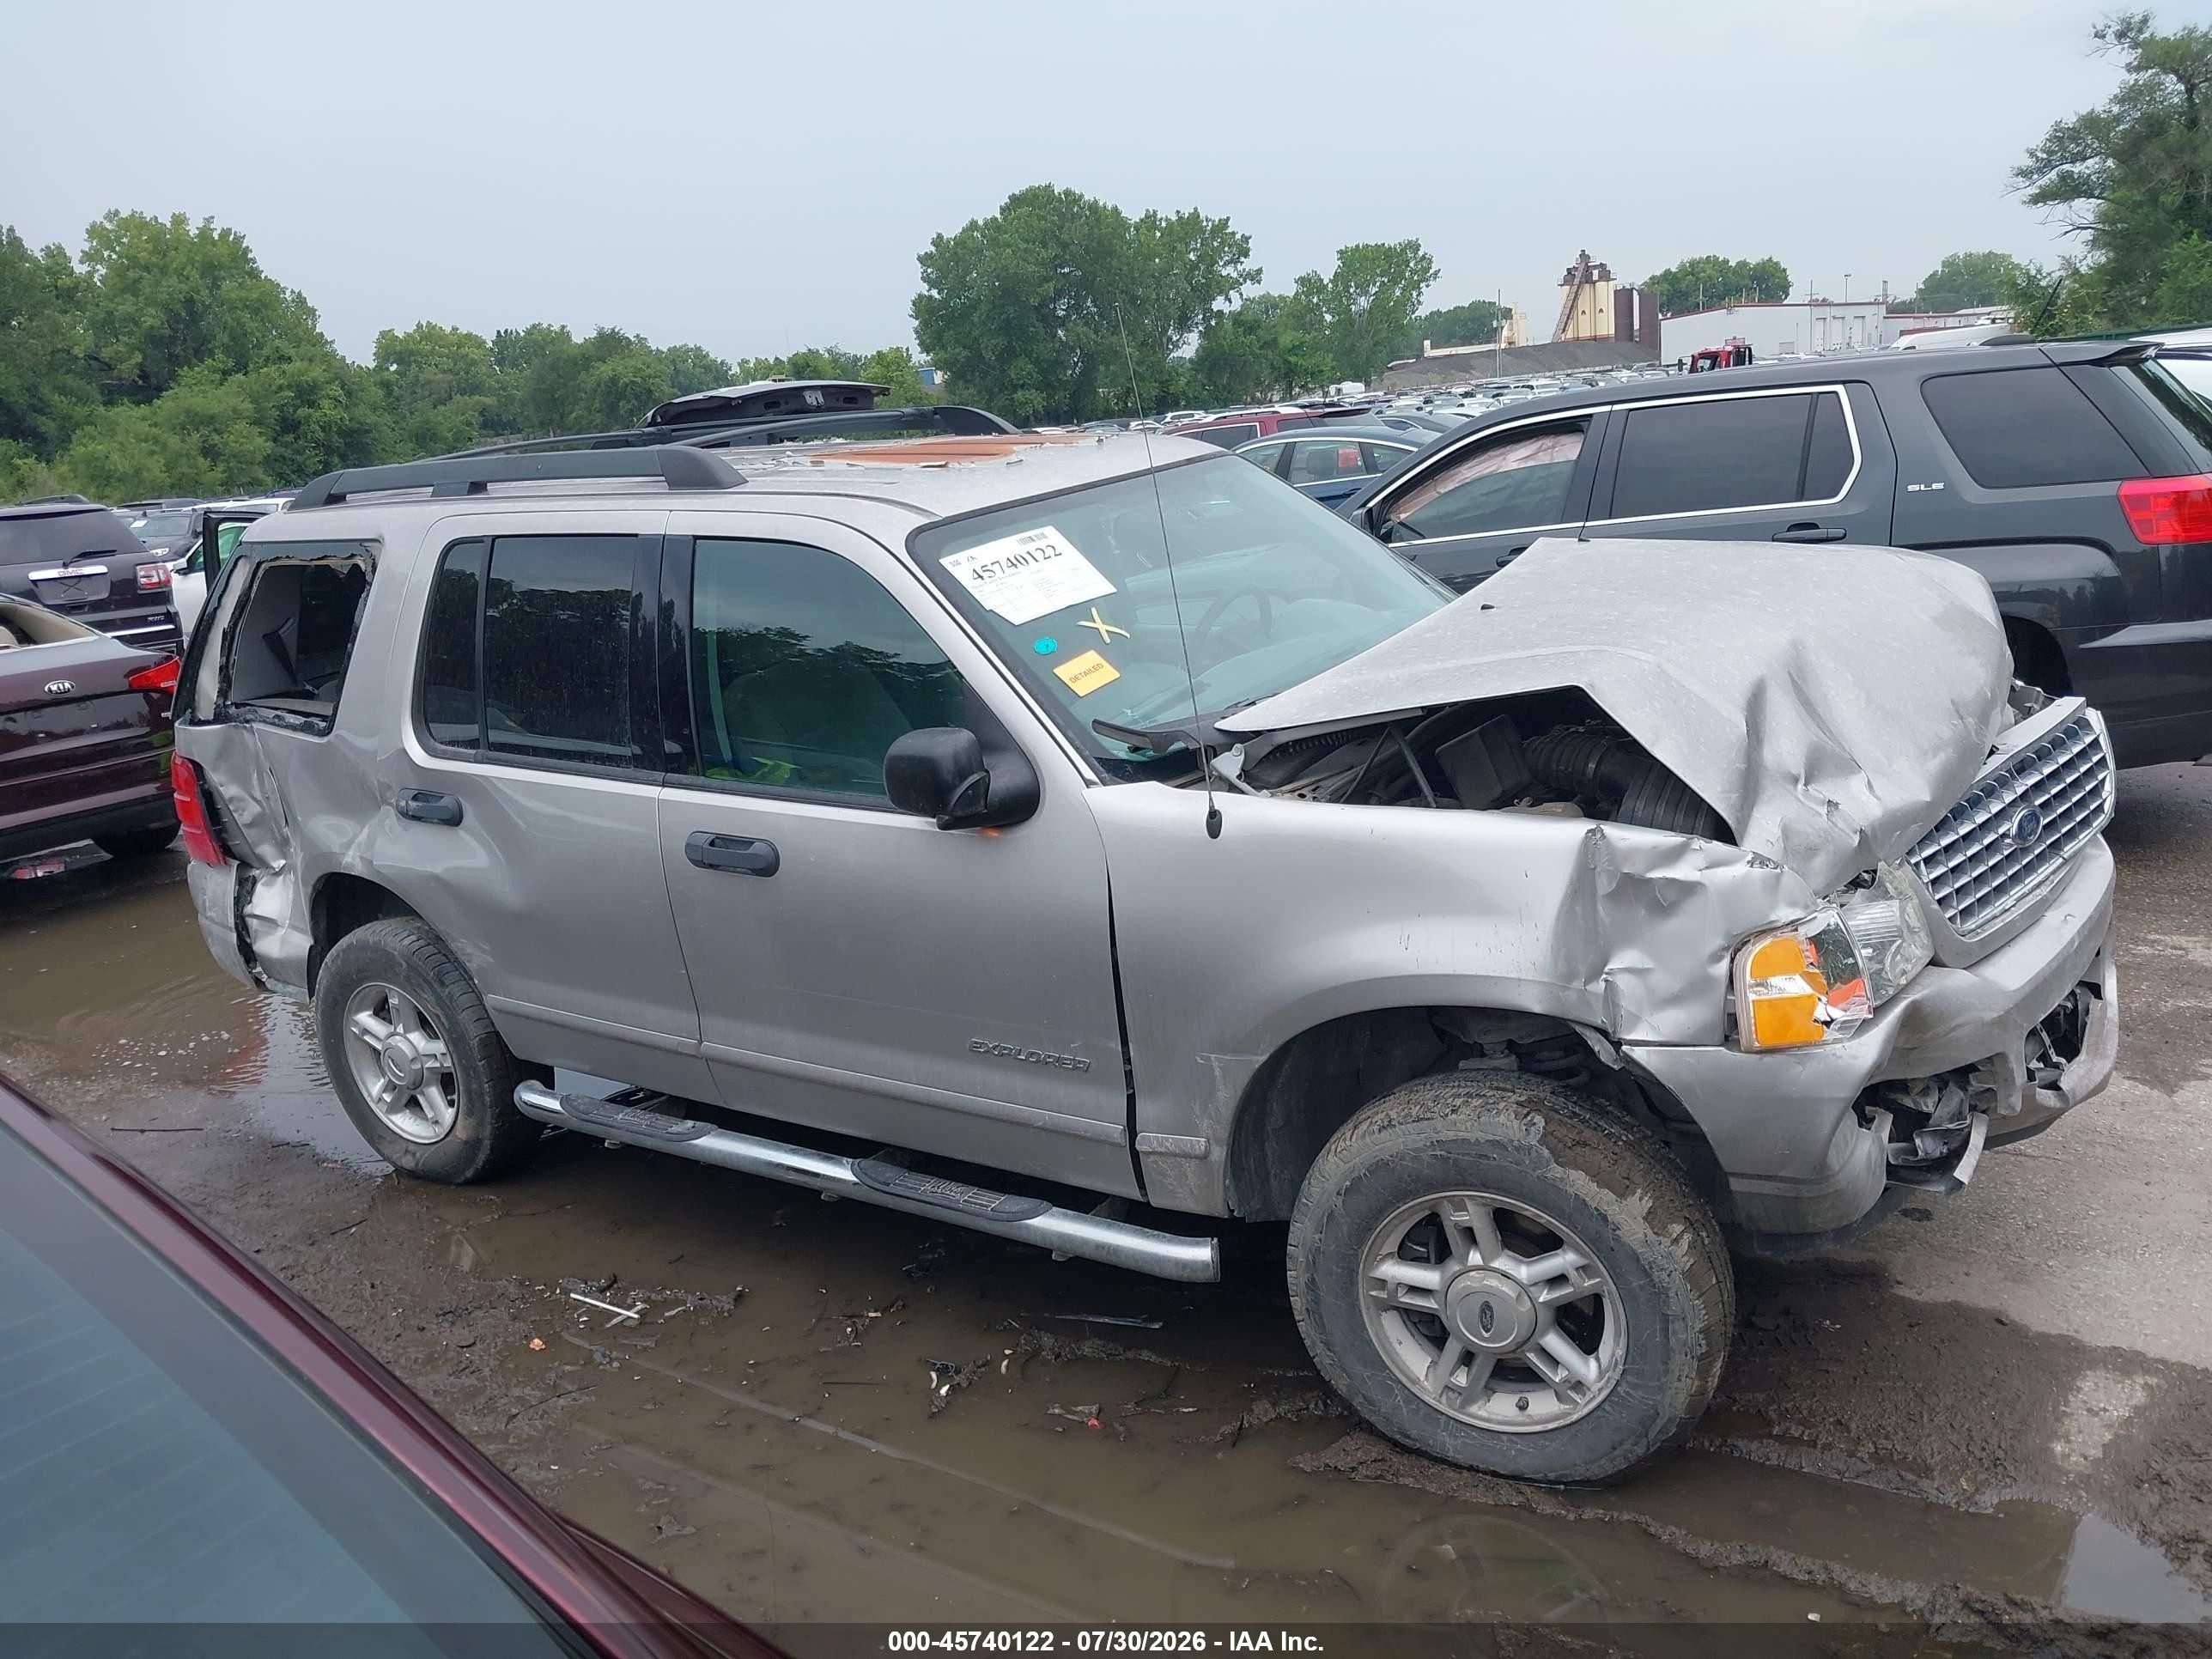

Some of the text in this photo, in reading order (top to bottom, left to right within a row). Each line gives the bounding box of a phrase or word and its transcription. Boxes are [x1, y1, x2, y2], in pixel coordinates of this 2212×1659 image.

[1907, 483, 1944, 492] SLE
[971, 544, 1062, 581] 45740122
[58, 568, 83, 577] GMC
[1069, 663, 1104, 684] DETAILED
[49, 682, 73, 694] KIA
[969, 1038, 1091, 1073] EXPLORER
